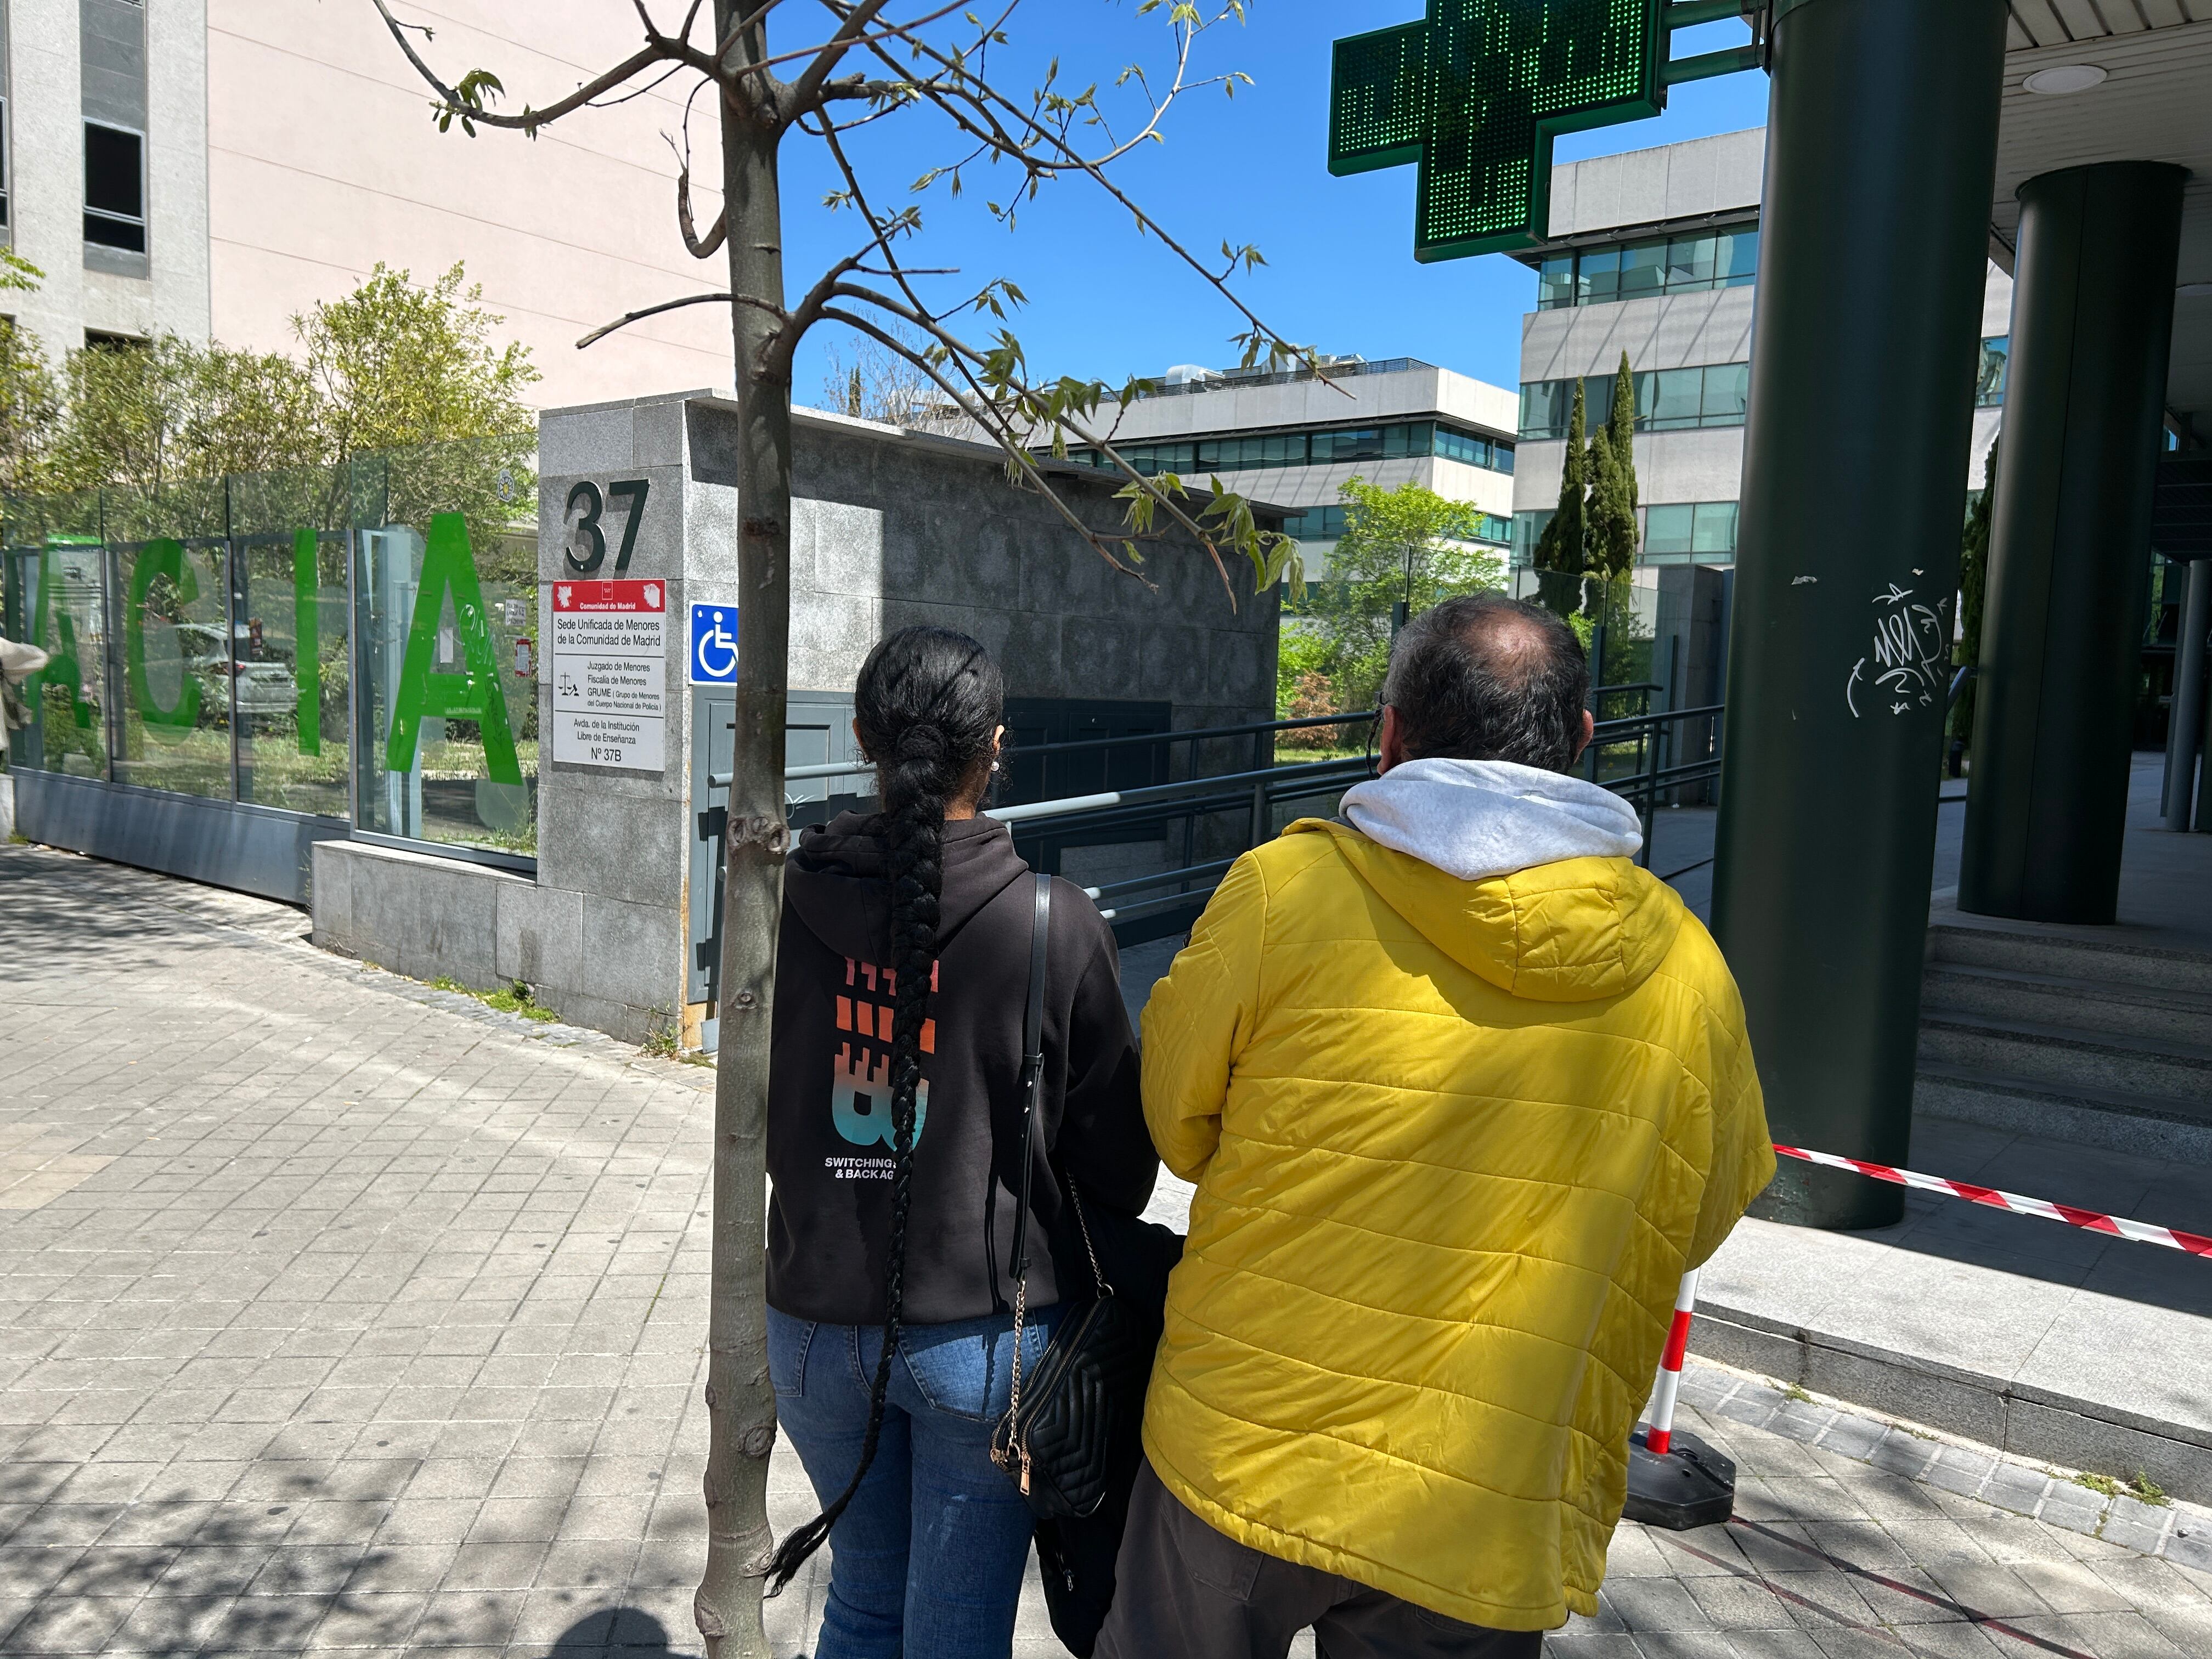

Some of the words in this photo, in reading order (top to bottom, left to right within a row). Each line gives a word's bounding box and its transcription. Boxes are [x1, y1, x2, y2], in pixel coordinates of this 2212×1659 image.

[566, 478, 651, 572] 37
[579, 602, 608, 610] Comunidad
[610, 602, 617, 610] de
[617, 602, 636, 610] Madrid
[557, 618, 576, 630] Sede
[578, 619, 612, 630] Unificada
[614, 619, 624, 630] de
[626, 619, 659, 630] Menores
[557, 634, 567, 644] de
[568, 634, 574, 645] la
[577, 634, 619, 645] Comunidad
[621, 634, 631, 645] de
[633, 635, 661, 646] Madrid
[588, 661, 613, 672] Juzgado
[614, 662, 622, 671] de
[624, 662, 650, 672] Menores
[588, 674, 610, 685] Fiscalía
[611, 675, 618, 685] de
[620, 676, 647, 686] Menores
[588, 687, 611, 697] GRUME
[616, 691, 630, 699] Grupo
[639, 692, 659, 700] Menores
[595, 700, 613, 708] Cuerpo
[574, 718, 590, 728] Avda.
[592, 720, 600, 729] de
[601, 720, 607, 729] la
[608, 720, 640, 732] Institución
[577, 731, 592, 741] Libre
[593, 733, 601, 741] de
[603, 733, 636, 744] Enseñanza
[591, 747, 602, 760] Nº
[604, 748, 622, 762] 37B
[835, 1169, 844, 1178] &
[845, 1169, 879, 1179] BACK
